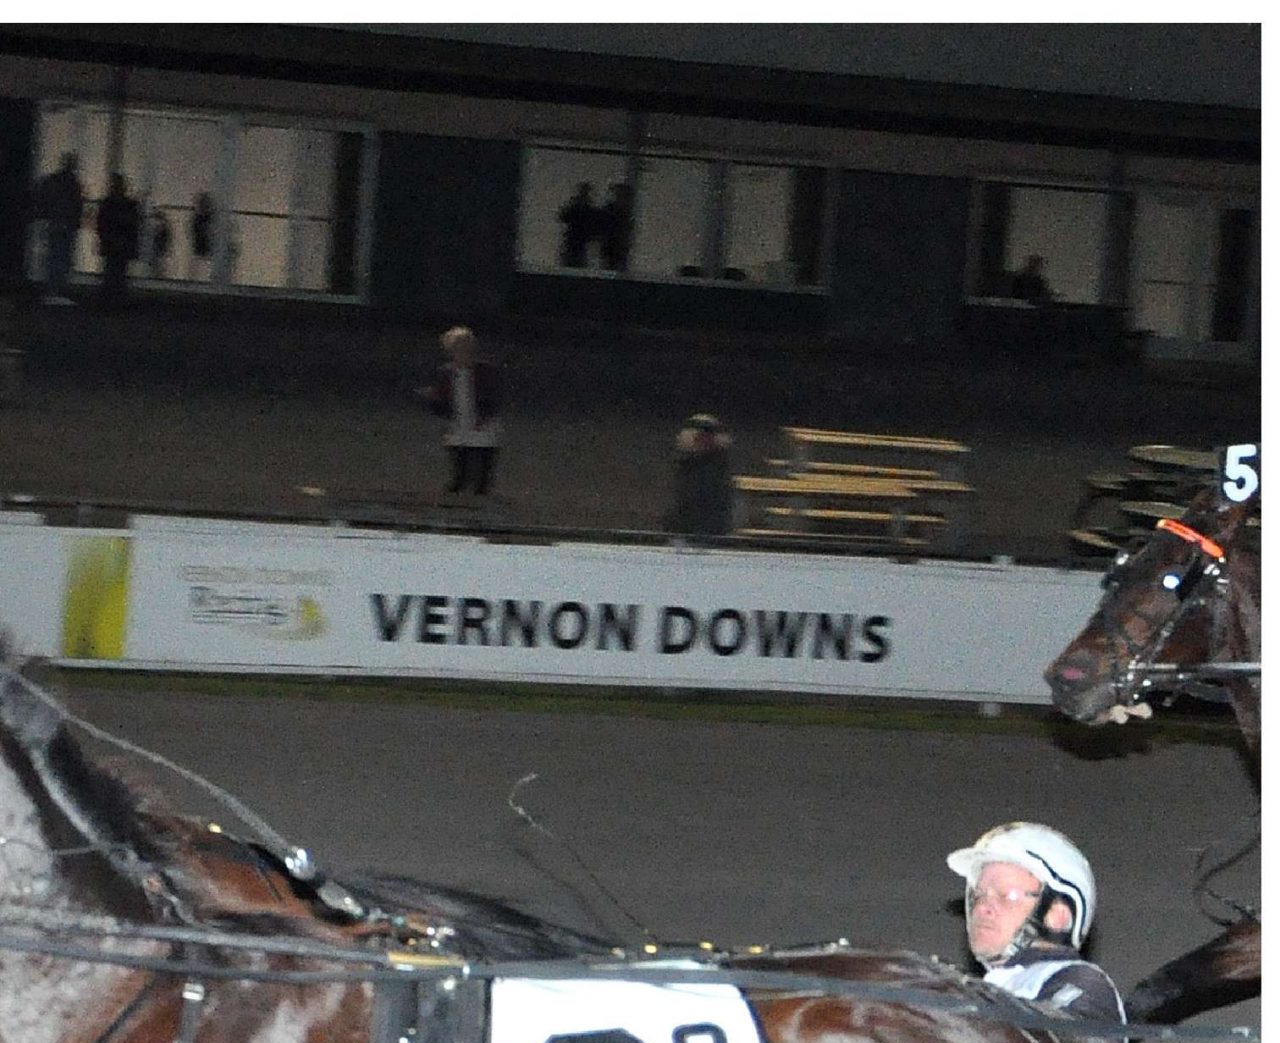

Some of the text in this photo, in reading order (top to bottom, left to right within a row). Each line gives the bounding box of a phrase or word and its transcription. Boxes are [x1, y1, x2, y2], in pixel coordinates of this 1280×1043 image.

[1223, 443, 1259, 502] 5
[371, 593, 893, 664] VERNON DOWNS
